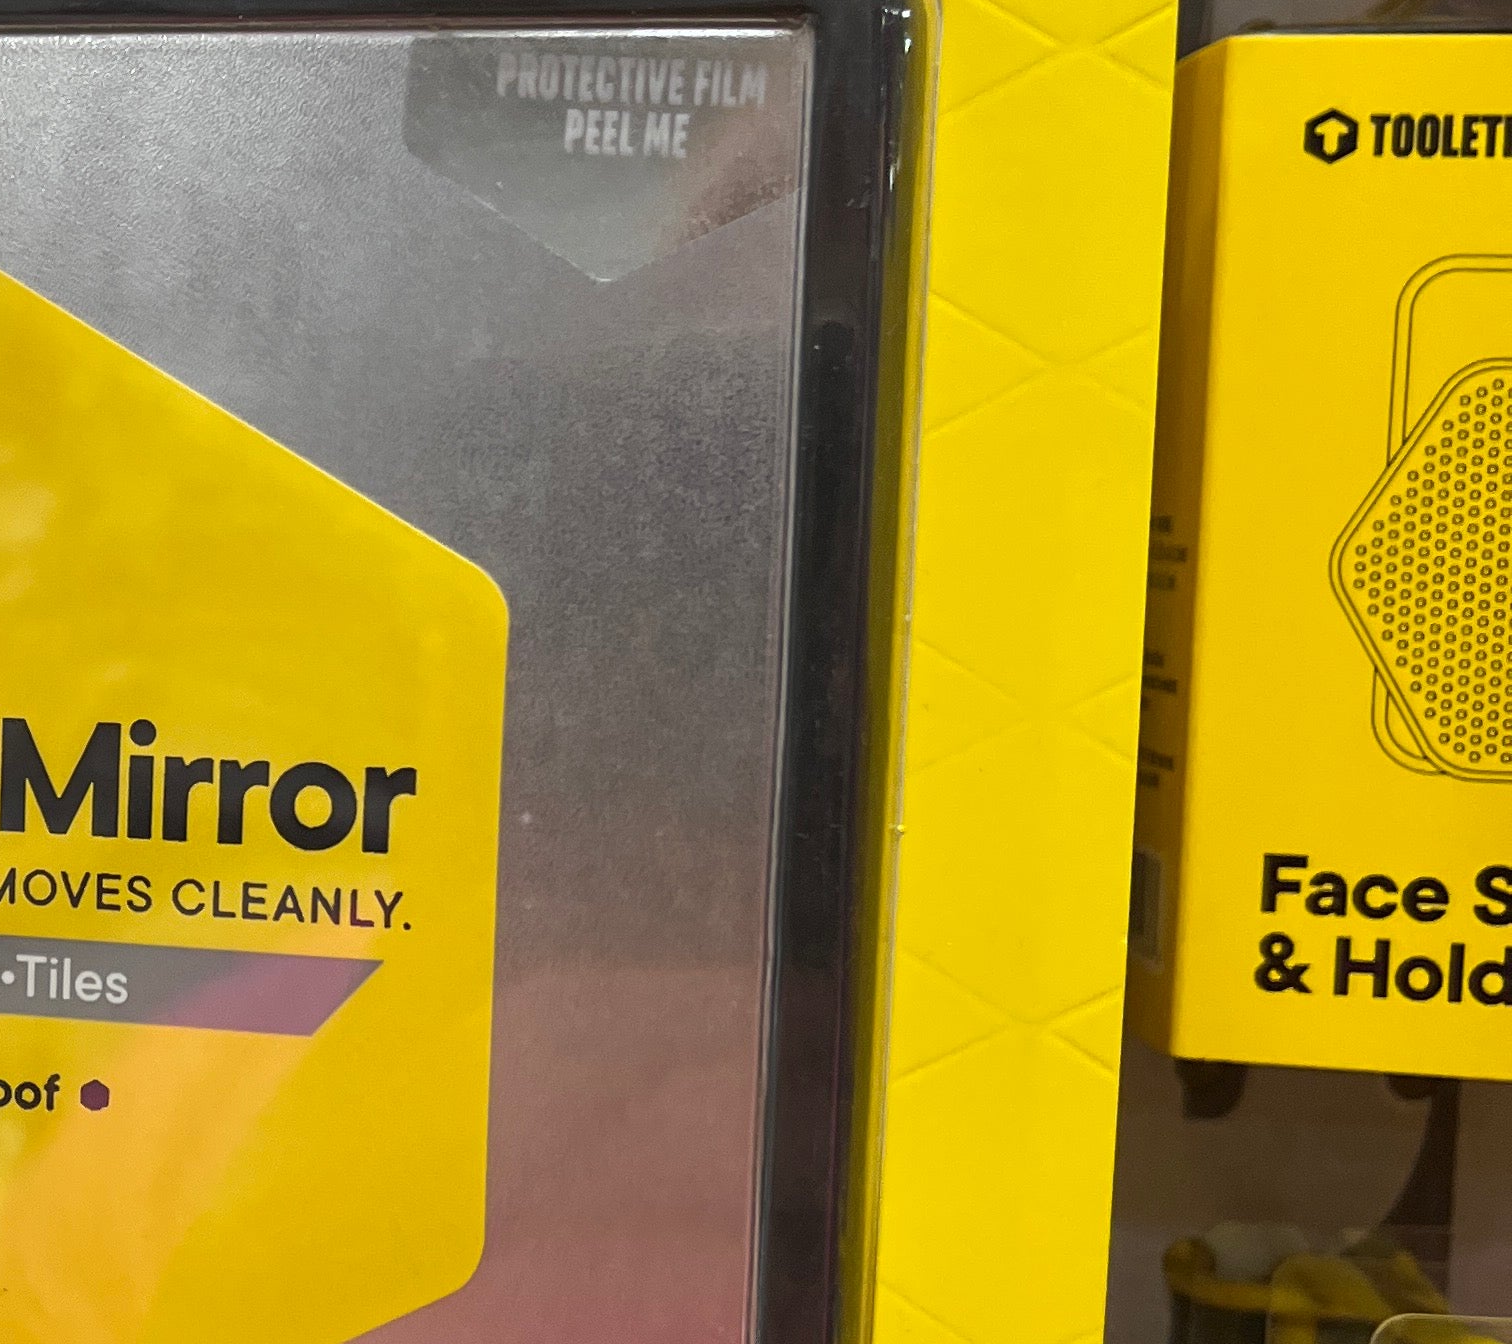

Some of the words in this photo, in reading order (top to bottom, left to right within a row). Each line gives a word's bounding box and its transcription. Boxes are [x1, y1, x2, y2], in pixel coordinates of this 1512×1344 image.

[495, 53, 685, 106] PROTECTIVE
[693, 58, 769, 108] FILM
[563, 107, 635, 156] PEEL
[642, 111, 691, 157] ME
[172, 878, 413, 931] CLEANLY.
[1260, 852, 1450, 923] Face
[1254, 931, 1313, 994] &
